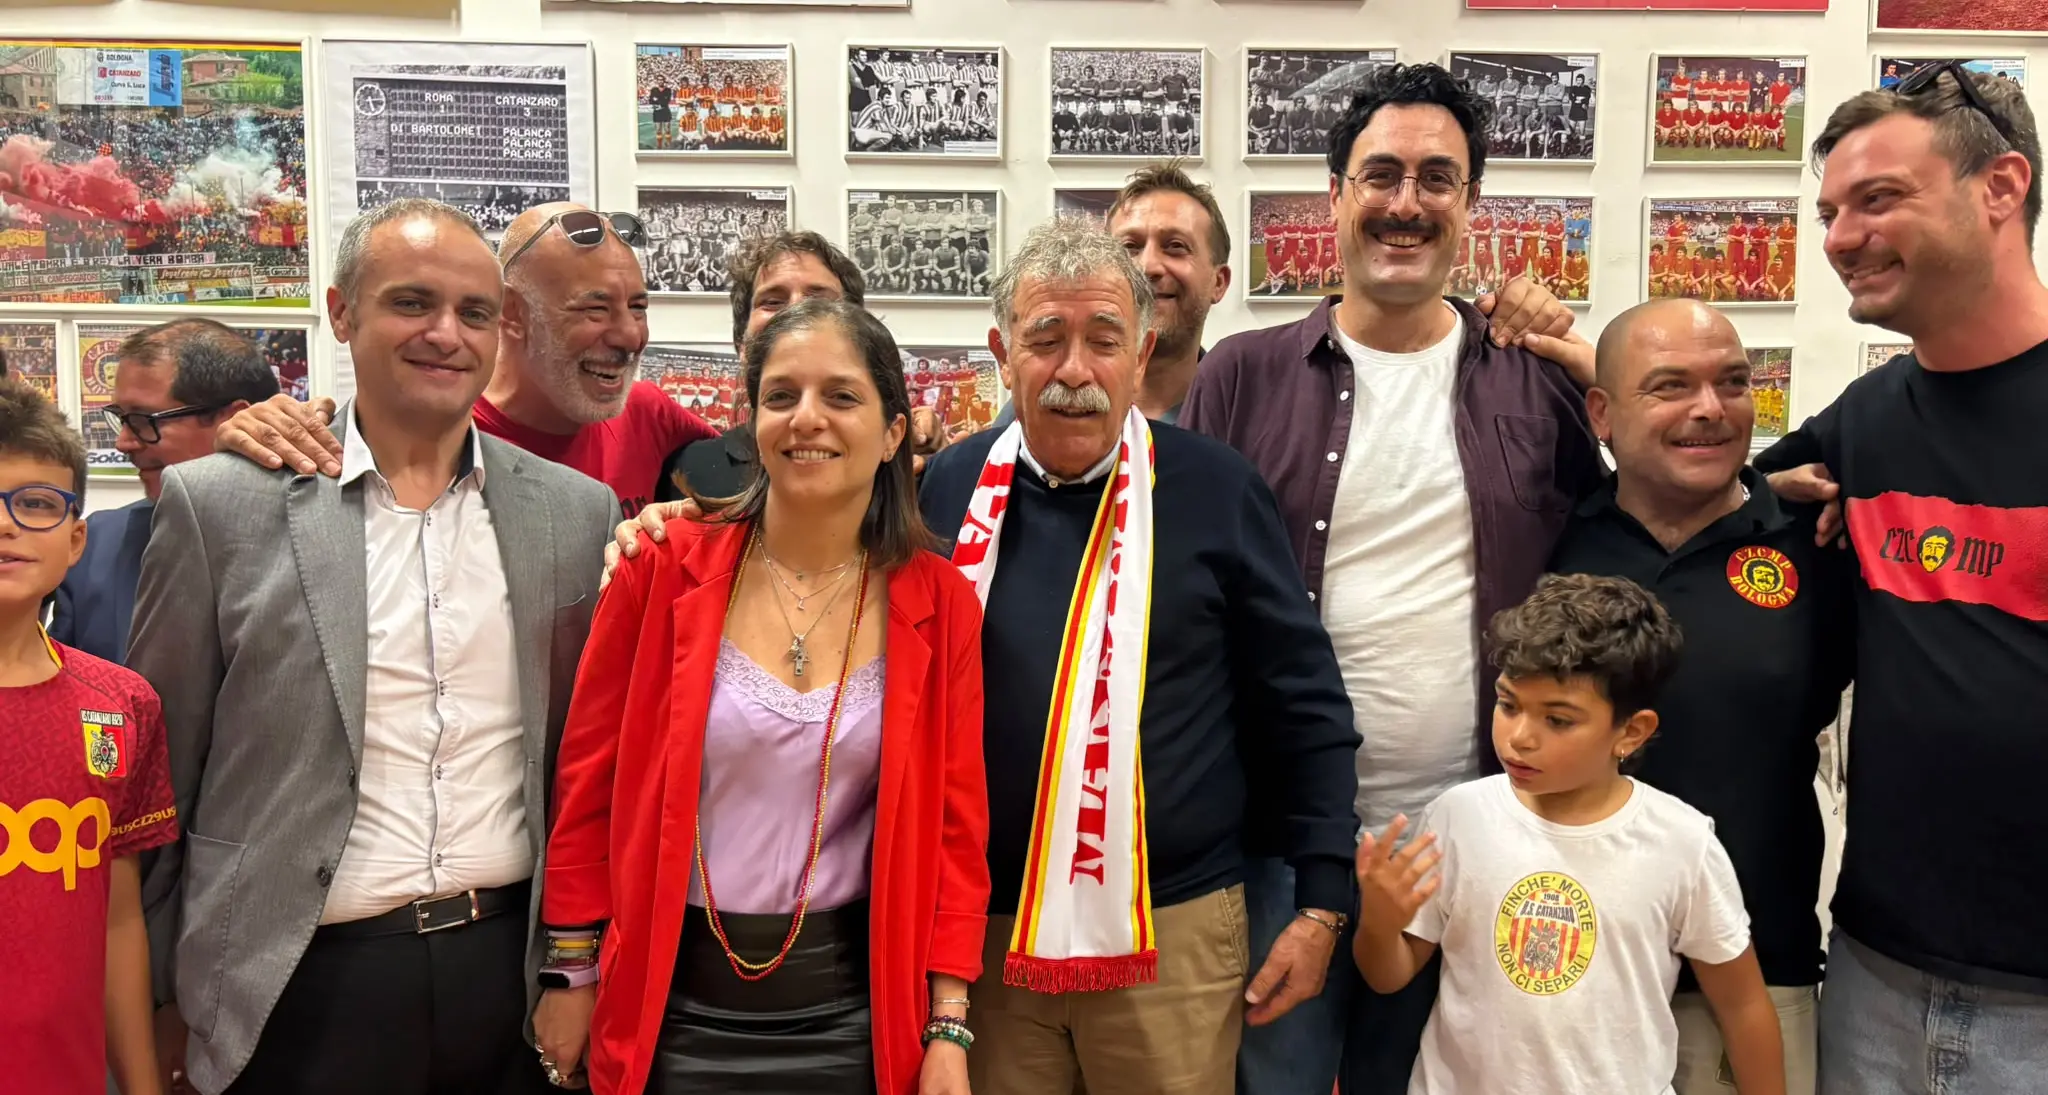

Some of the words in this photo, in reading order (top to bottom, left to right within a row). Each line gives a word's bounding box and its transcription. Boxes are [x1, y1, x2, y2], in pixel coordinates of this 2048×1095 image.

[108, 69, 142, 77] CATANZARO
[424, 92, 454, 103] ROMA
[495, 95, 559, 107] CATANZARO
[439, 104, 445, 113] 1
[523, 107, 531, 117] 3
[390, 124, 404, 133] DI
[411, 124, 482, 136] BARTOLOMEI
[502, 127, 552, 138] PALANCA
[502, 138, 553, 149] PALANCA
[502, 148, 553, 159] PALANCA
[1729, 575, 1796, 606] BOLOGNA
[1558, 879, 1594, 932] MORTE
[1535, 903, 1575, 924] CATANZARO
[1497, 942, 1517, 975] NON
[1515, 973, 1531, 989] CI
